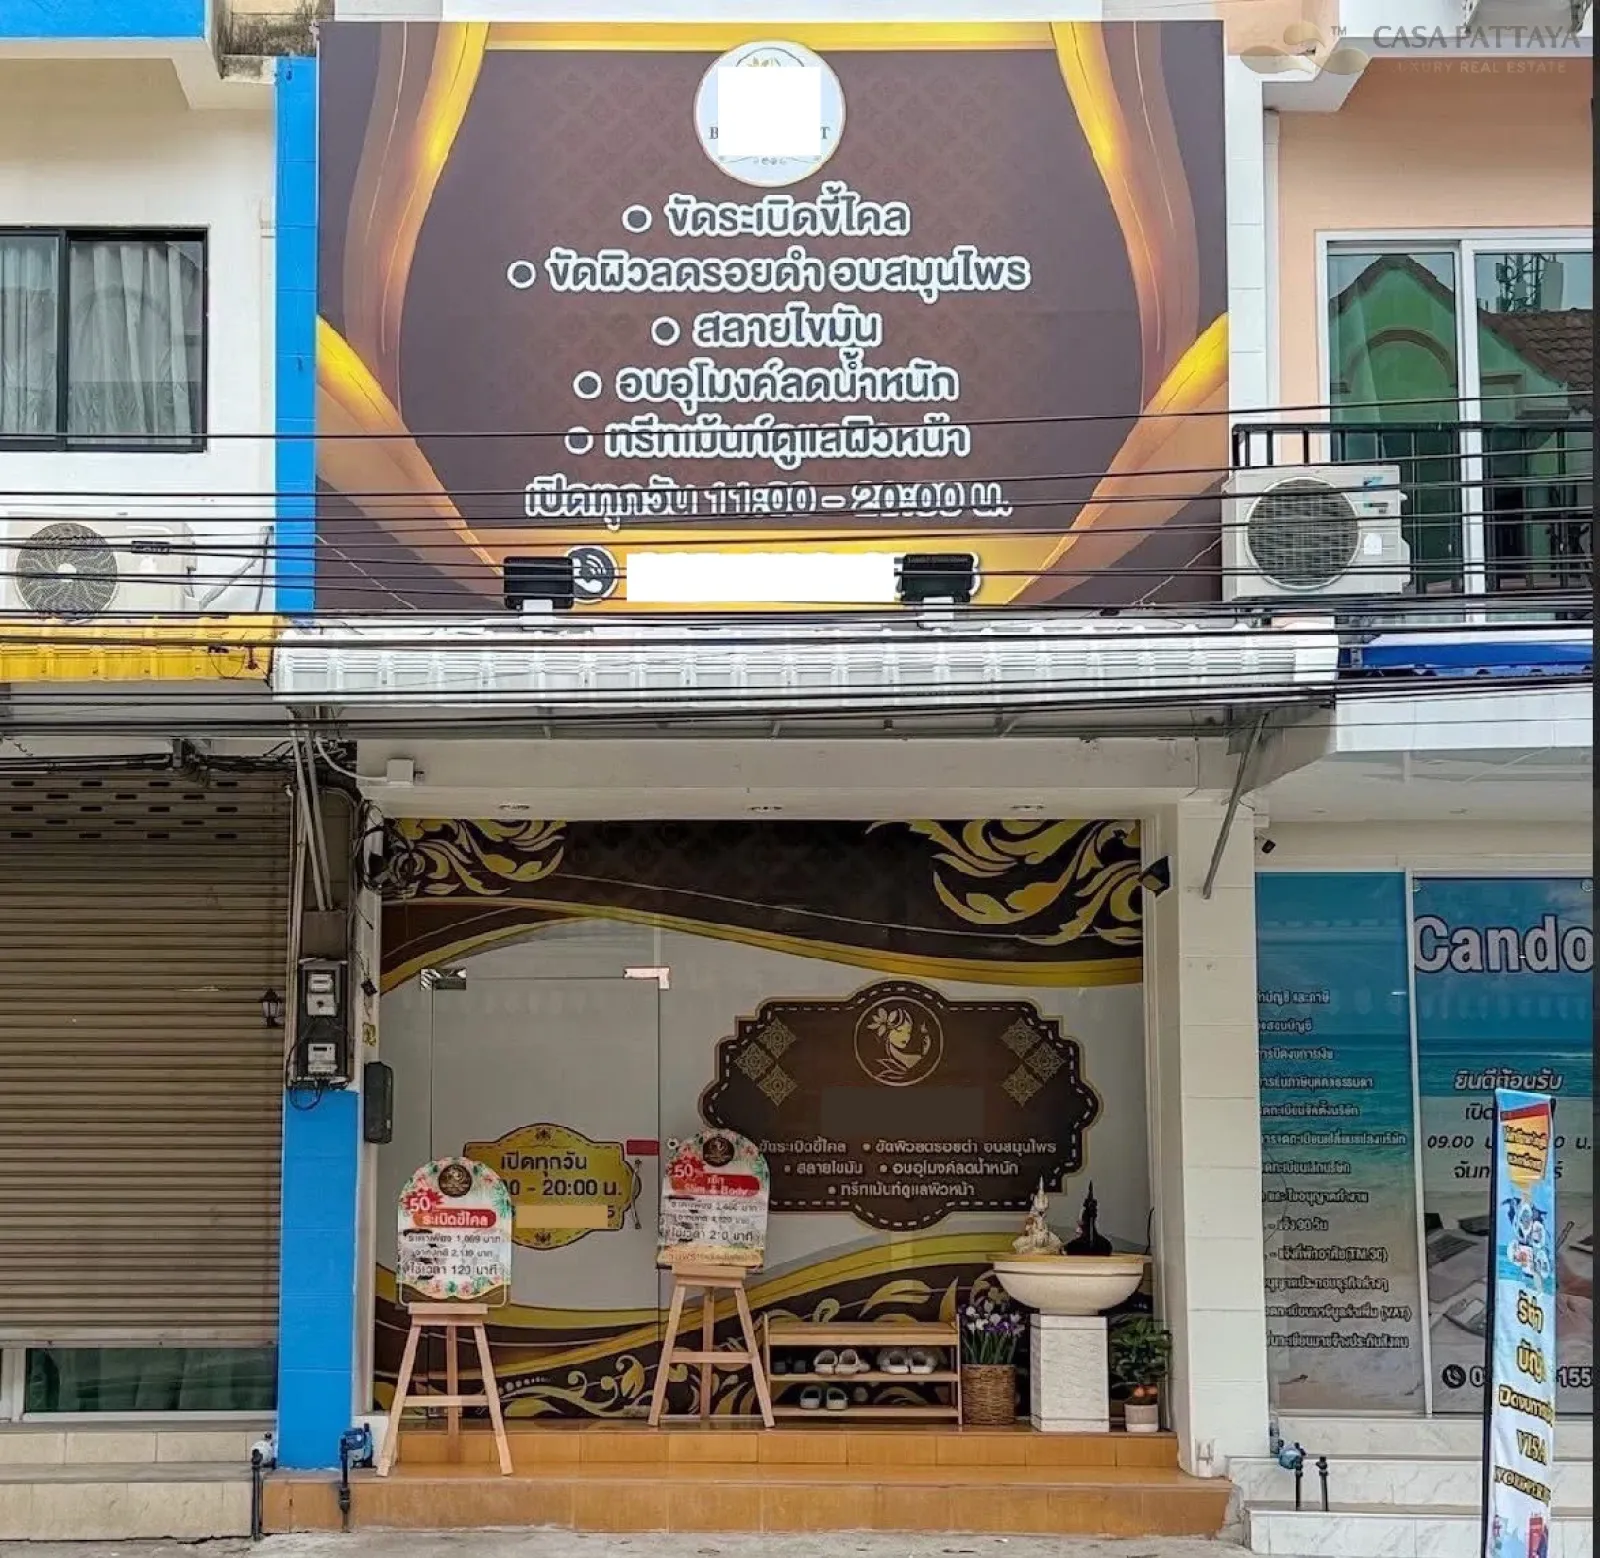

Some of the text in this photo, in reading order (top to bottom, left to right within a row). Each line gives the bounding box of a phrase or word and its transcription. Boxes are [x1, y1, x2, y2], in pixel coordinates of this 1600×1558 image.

[667, 182, 909, 236] ขัดระเบิดขี้ไคล
[546, 244, 1031, 304] ขัดผิวลดรอยดำ อบสมุนไพร
[692, 303, 882, 349] สลายไขมัน
[616, 347, 959, 414] อบอุโมงค์ลดน้ำหนัก
[604, 413, 971, 469] ทรีทเม้นท์ดูแลผิวหน้า
[525, 473, 699, 531] เปิดทุกวัน
[703, 481, 816, 517] 11:00
[851, 481, 964, 517] 20:00
[971, 482, 1013, 517] น.
[1414, 914, 1593, 973] Cando
[1454, 1067, 1563, 1090] ยินดีต้อนรับ
[501, 1150, 587, 1177] เปิดทุกวัน
[1427, 1133, 1475, 1149] 09.00
[543, 1178, 598, 1197] 20:00
[604, 1179, 622, 1197] น.
[797, 1160, 863, 1175] สลายไขมัน
[1515, 1428, 1547, 1466] VISA
